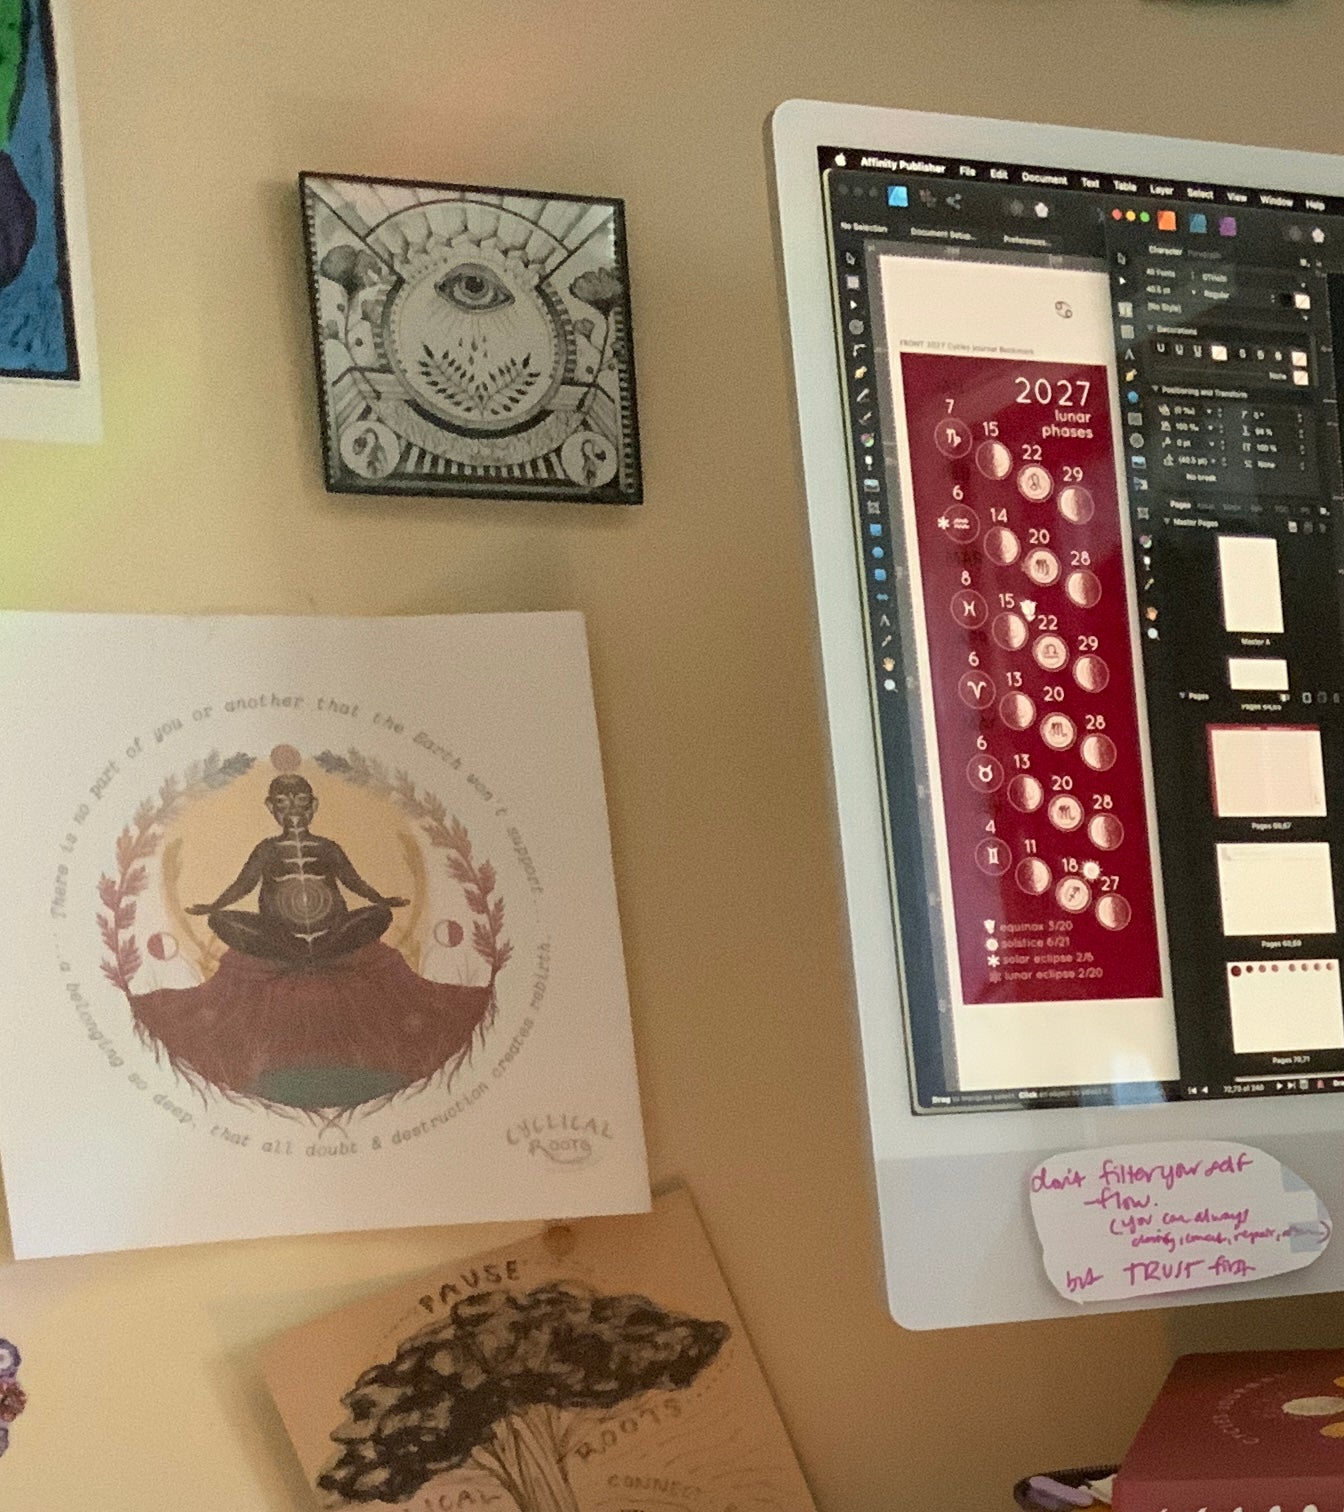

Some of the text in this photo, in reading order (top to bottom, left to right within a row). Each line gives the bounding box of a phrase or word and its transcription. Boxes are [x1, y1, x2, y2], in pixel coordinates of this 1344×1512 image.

[861, 156, 898, 170] Affinity
[900, 160, 946, 174] Publisher
[959, 166, 976, 177] File
[990, 169, 1008, 180] Edit
[1022, 172, 1068, 185] Document
[1114, 180, 1137, 193] Table
[1150, 184, 1174, 197] Layer
[1187, 187, 1214, 200] Select
[1260, 194, 1294, 207] Window
[1305, 199, 1326, 211] Help
[1014, 376, 1092, 407] 2027
[946, 398, 955, 413] 7
[1054, 409, 1092, 423] lunar
[982, 421, 999, 437] 15
[1041, 423, 1094, 439] phases
[1022, 444, 1043, 460] 22
[1062, 466, 1083, 482] 29
[952, 486, 964, 500] 6
[990, 508, 1008, 523] 14
[1028, 529, 1050, 544] 20
[1070, 551, 1091, 565] 28
[961, 570, 971, 585] 8
[998, 593, 1015, 608] 15
[1038, 615, 1059, 630] 22
[1078, 635, 1099, 651] 29
[968, 651, 980, 667] 6
[1006, 672, 1023, 687] 13
[1043, 686, 1064, 702] 20
[1085, 715, 1106, 729] 28
[976, 735, 987, 750] 6
[1014, 754, 1030, 769] 13
[1051, 775, 1073, 790] 20
[50, 854, 71, 921] There
[62, 829, 79, 854] is
[73, 803, 92, 827] no
[88, 759, 123, 801] part
[125, 735, 147, 761] of
[153, 715, 186, 745] you
[191, 704, 215, 724] or
[223, 692, 305, 714] another
[316, 694, 361, 720] that
[372, 709, 407, 736] the
[411, 730, 463, 775] Earth
[1092, 794, 1113, 809] 28
[985, 819, 996, 834] 4
[1025, 839, 1036, 853] 11
[1061, 858, 1078, 872] 18
[1101, 876, 1119, 891] 27
[1000, 922, 1044, 933] equinox
[1001, 938, 1044, 949] solstice
[1003, 954, 1030, 965] solar
[1034, 953, 1073, 965] eclipse
[1004, 970, 1032, 981] lunar
[1036, 969, 1076, 981] eclipse
[65, 980, 127, 1070] belonging
[127, 1072, 151, 1096] so
[209, 1122, 252, 1150] that
[261, 1137, 295, 1157] all
[306, 1138, 359, 1159] doubt
[390, 1080, 492, 1148] destruction
[492, 1015, 537, 1081] creates
[1066, 1255, 1257, 1293] but TRUST first
[417, 1258, 523, 1315] PAUSE
[574, 1398, 682, 1460] ROOTS
